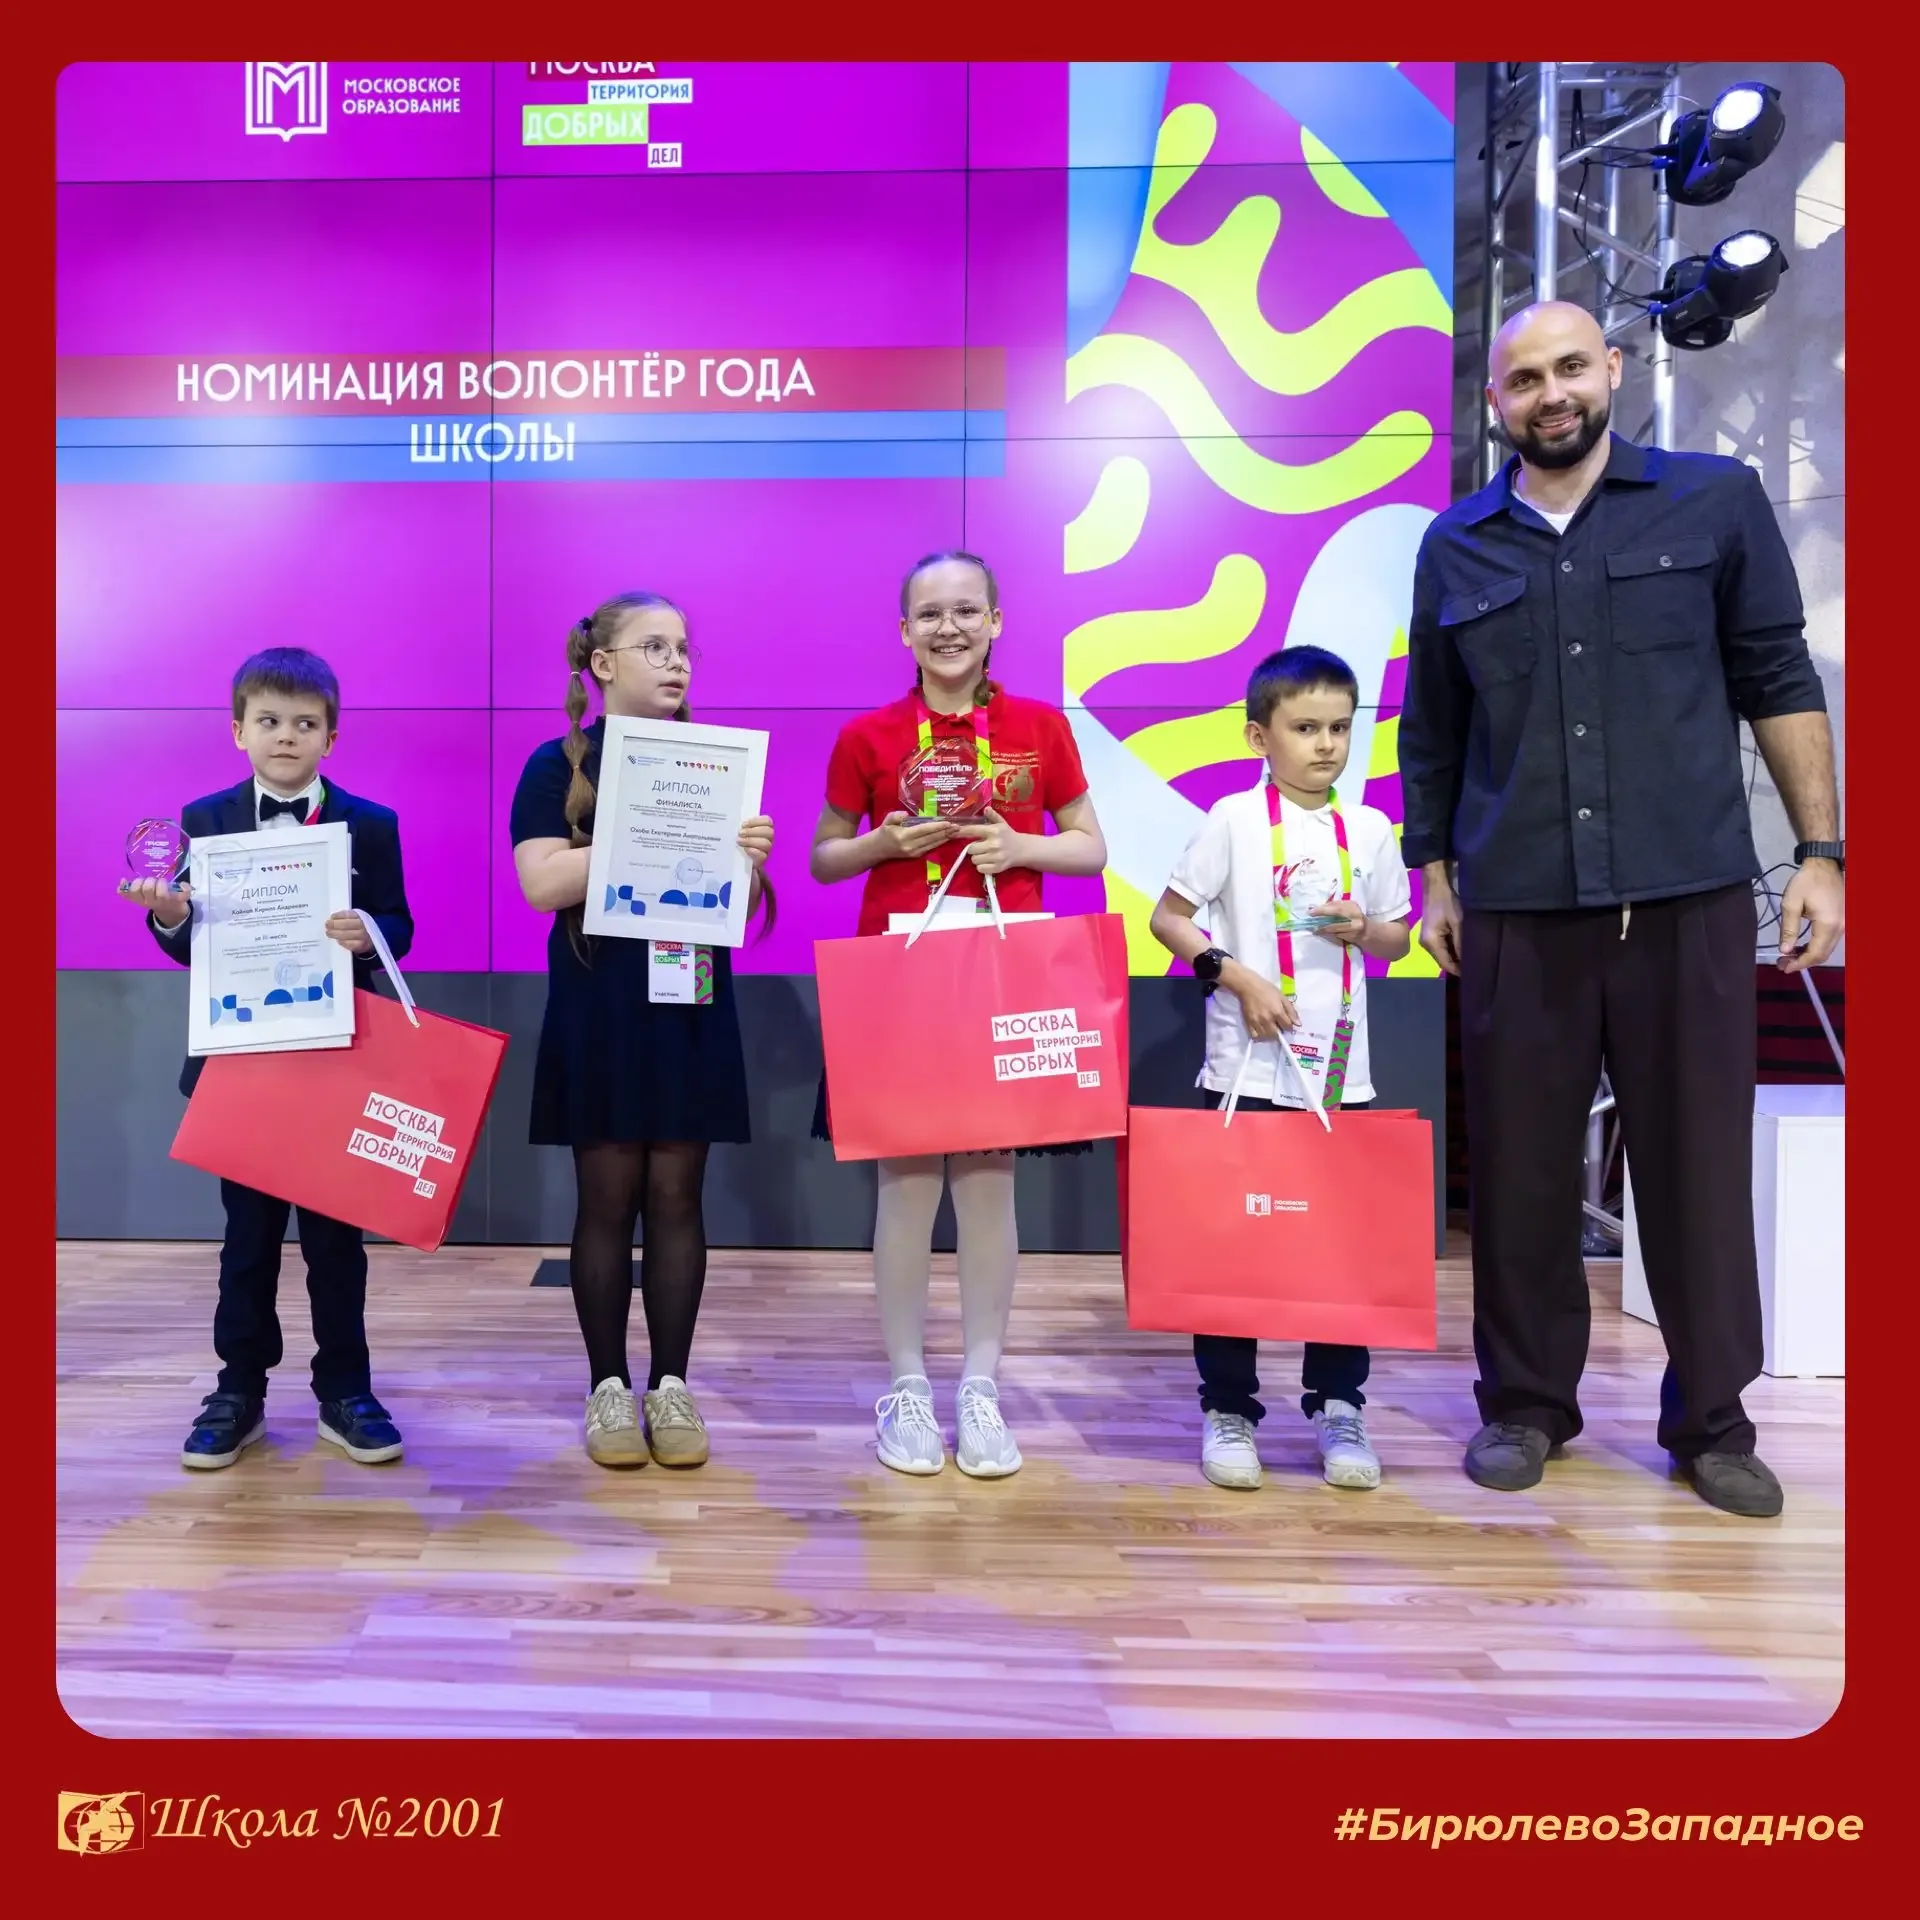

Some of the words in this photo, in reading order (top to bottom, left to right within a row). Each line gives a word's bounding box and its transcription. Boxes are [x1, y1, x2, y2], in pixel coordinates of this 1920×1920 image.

[343, 77, 461, 95] МОСКОВСКОЕ
[590, 83, 690, 100] ТЕРРИТОРИЯ
[342, 98, 461, 115] ОБРАЗОВАНИЕ
[524, 110, 646, 144] ДОБРЫХ
[650, 147, 679, 165] ДЕЛ
[177, 361, 444, 406] НОМИНАЦИЯ
[459, 351, 687, 400] ВОЛОНТЁР
[699, 358, 816, 403] ГОДА
[410, 421, 576, 464] ШКОЛЫ
[651, 779, 711, 797] ДИПЛОМ
[655, 798, 703, 810] ФИНАЛИСТА
[241, 883, 299, 900] ДИПЛОМ
[994, 1013, 1075, 1037] МОСКВА
[1035, 1033, 1101, 1049] ТЕРРИТОРИЯ
[998, 1051, 1075, 1078] ДОБРЫХ
[1079, 1072, 1099, 1085] ДЕЛ
[366, 1097, 438, 1137] МОСКВА
[350, 1133, 424, 1172] ДОБРЫХ
[396, 1131, 454, 1161] ТЕРРИТОРИЯ
[415, 1180, 436, 1195] ДЕЛ
